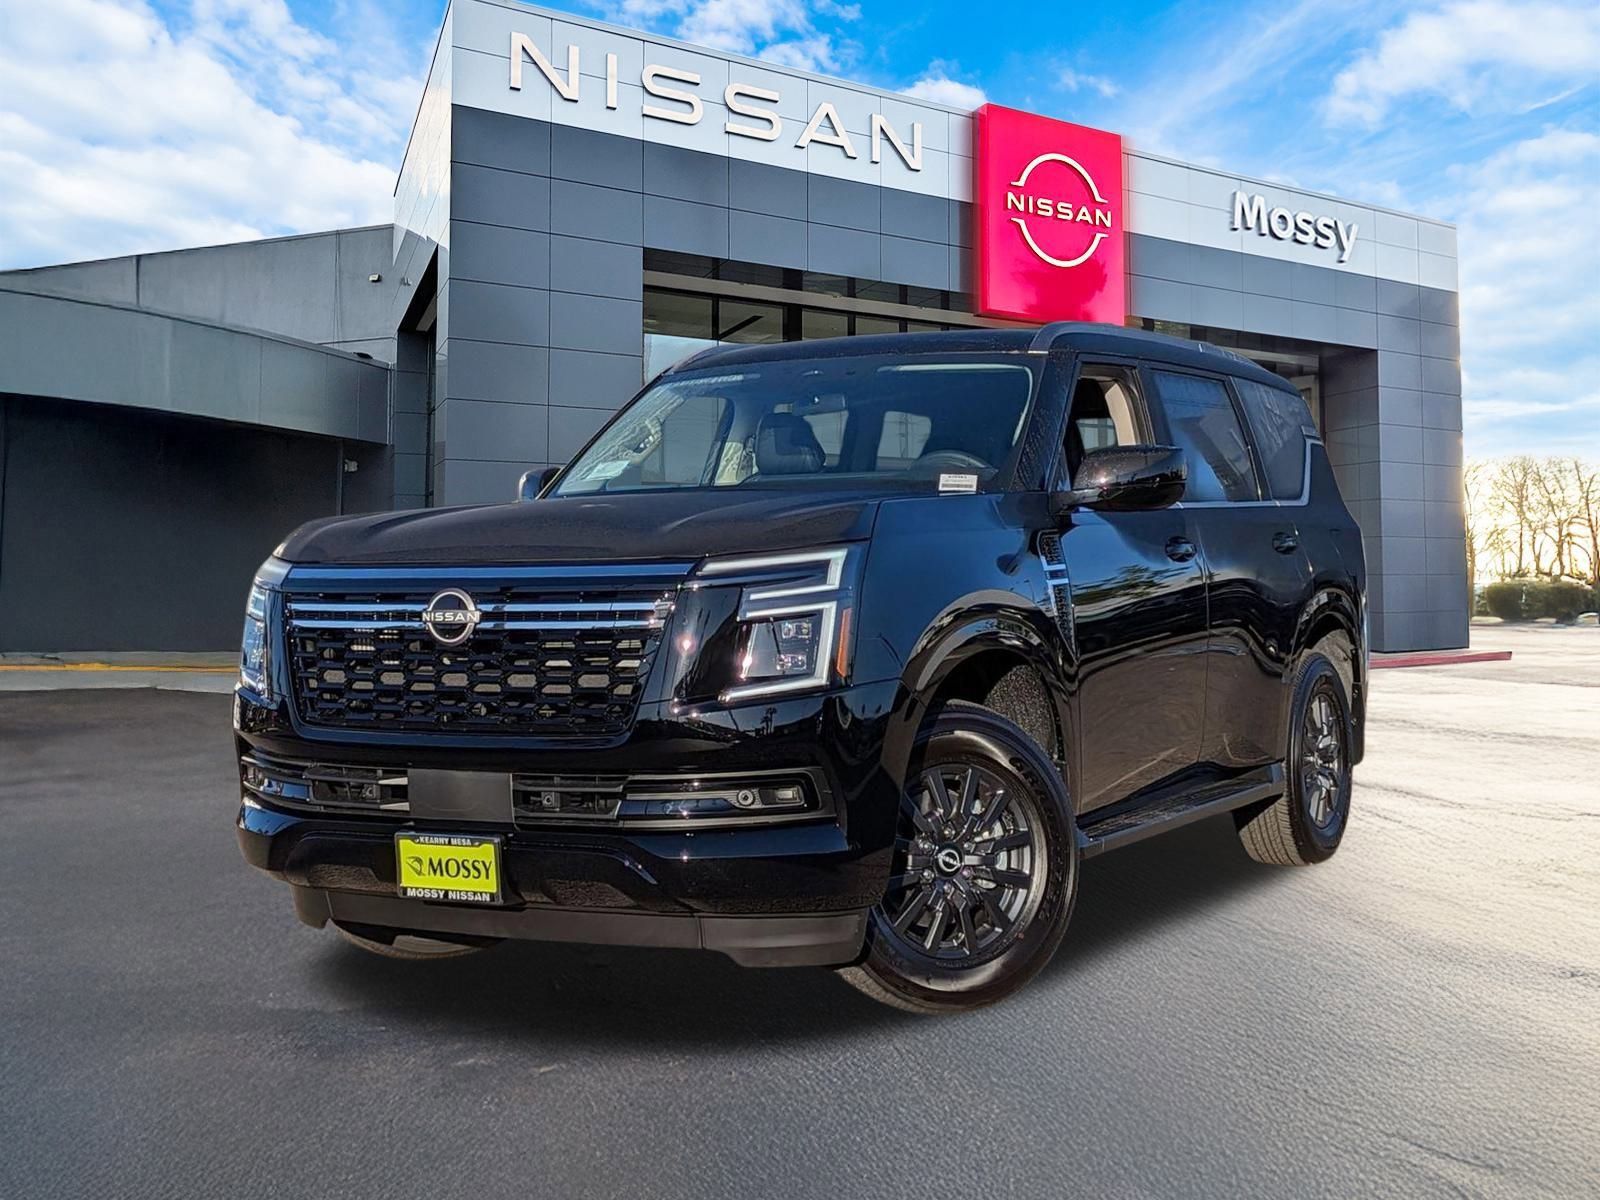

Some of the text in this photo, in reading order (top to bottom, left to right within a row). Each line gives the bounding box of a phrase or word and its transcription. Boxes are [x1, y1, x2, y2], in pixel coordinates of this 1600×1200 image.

[509, 31, 923, 172] NISSAN
[1006, 191, 1112, 228] NISSAN
[1231, 190, 1360, 263] Mossy
[422, 611, 480, 622] NISSAN
[450, 838, 472, 846] MESA
[428, 857, 492, 880] MOSSY
[407, 887, 490, 902] MOSSY NISSAN
